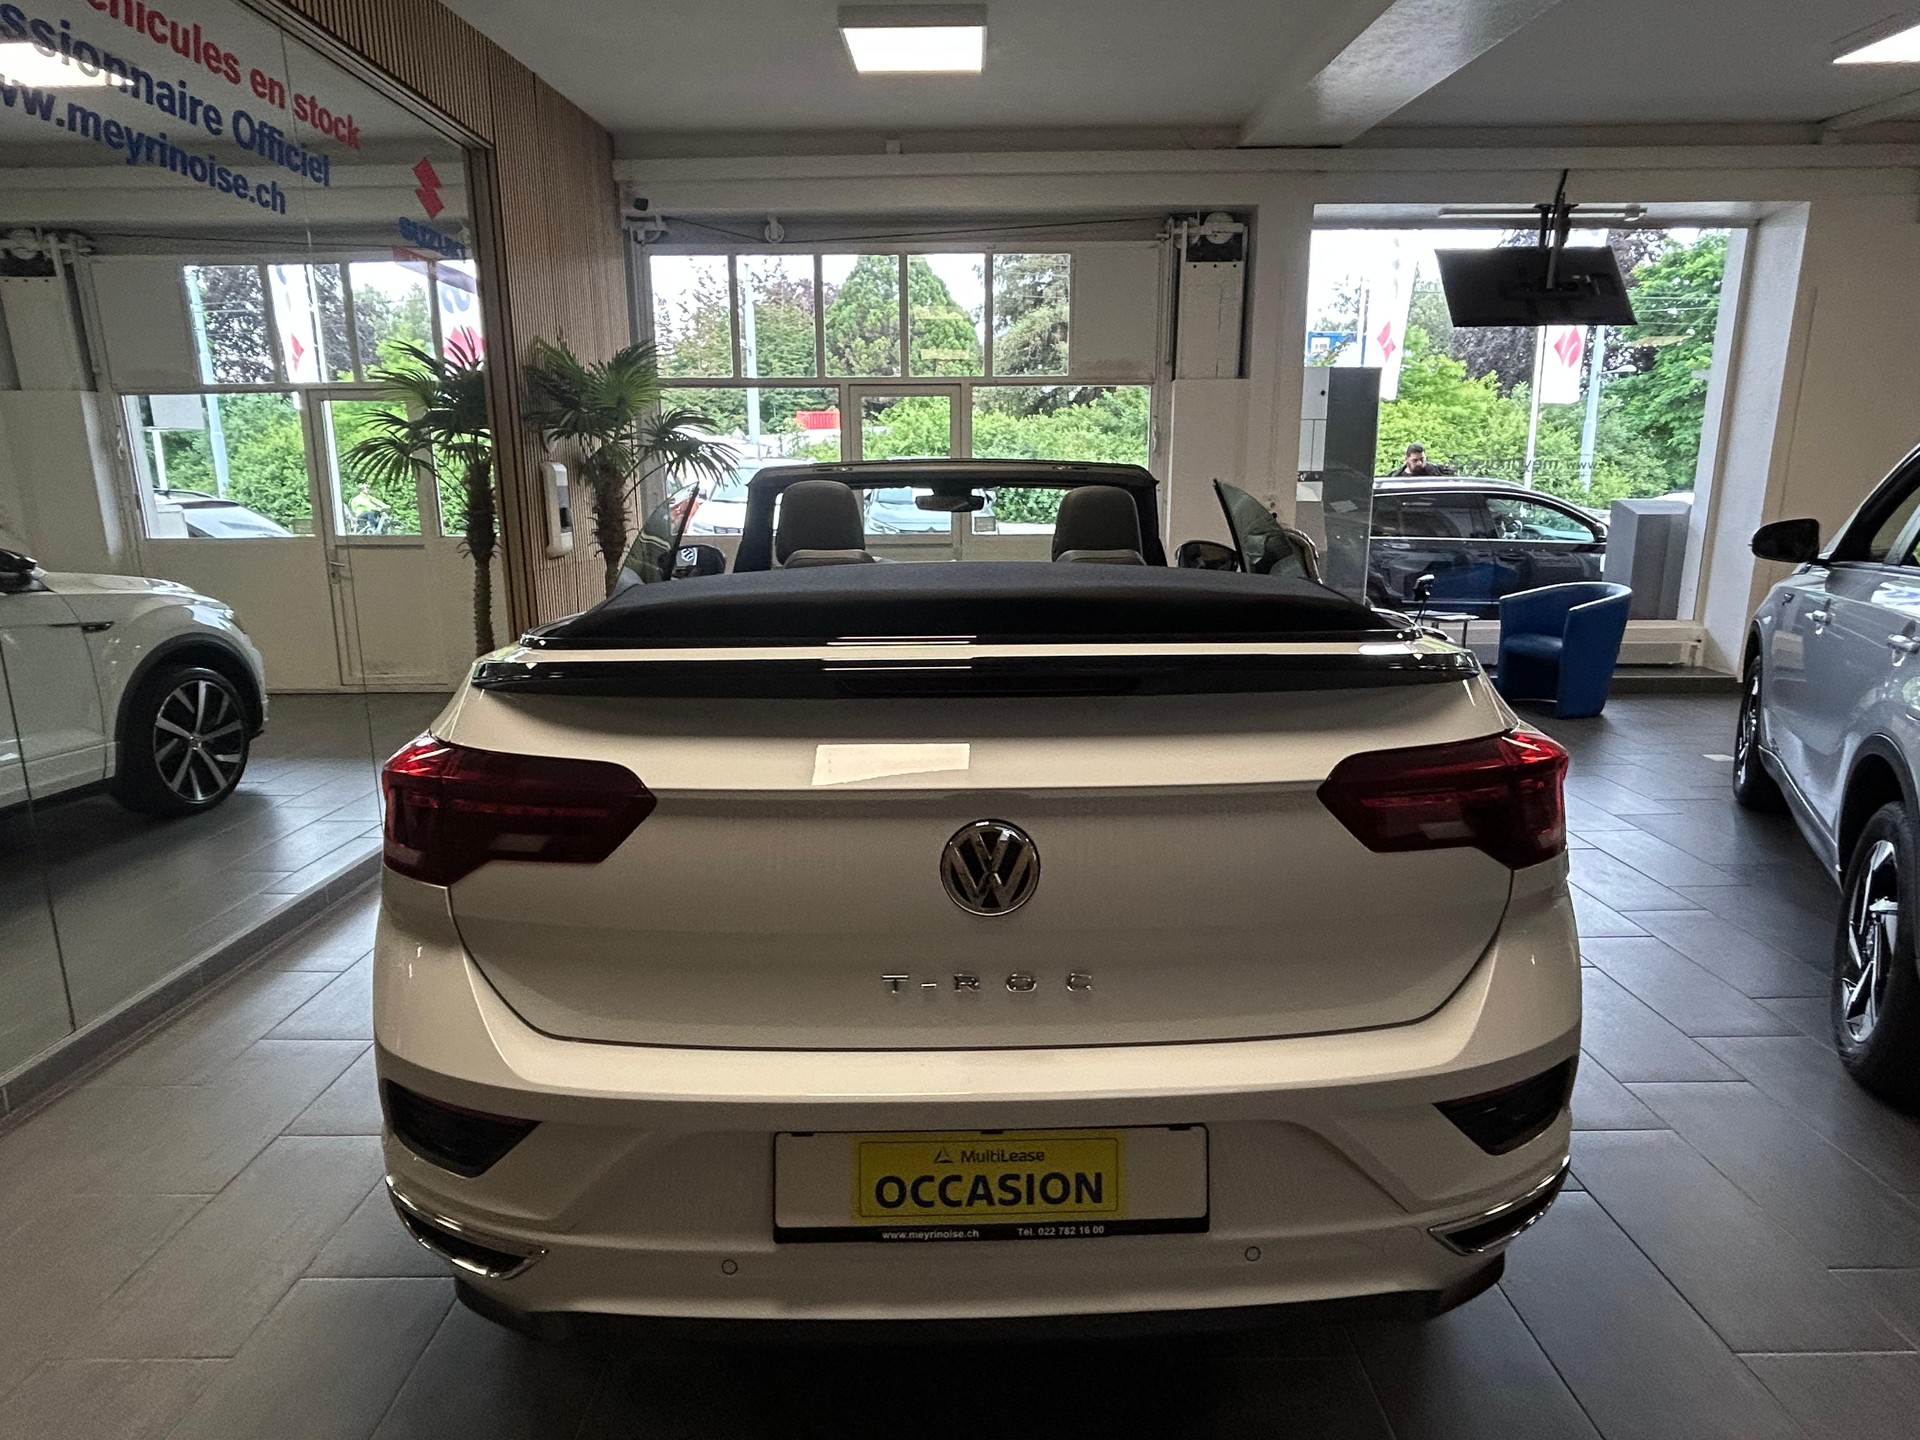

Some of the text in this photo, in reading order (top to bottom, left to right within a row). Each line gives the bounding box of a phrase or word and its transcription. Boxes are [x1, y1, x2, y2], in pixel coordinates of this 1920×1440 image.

[250, 68, 286, 109] en
[293, 92, 361, 149] stock
[232, 109, 330, 187] Officiel
[960, 1149, 1045, 1164] MultiLease
[874, 1171, 1104, 1209] OCCASION
[882, 1229, 980, 1241] www.meyrinoise.ch
[1038, 1226, 1056, 1236] 022
[1058, 1226, 1077, 1236] 782
[1079, 1226, 1090, 1235] 16
[1092, 1225, 1105, 1235] 00
